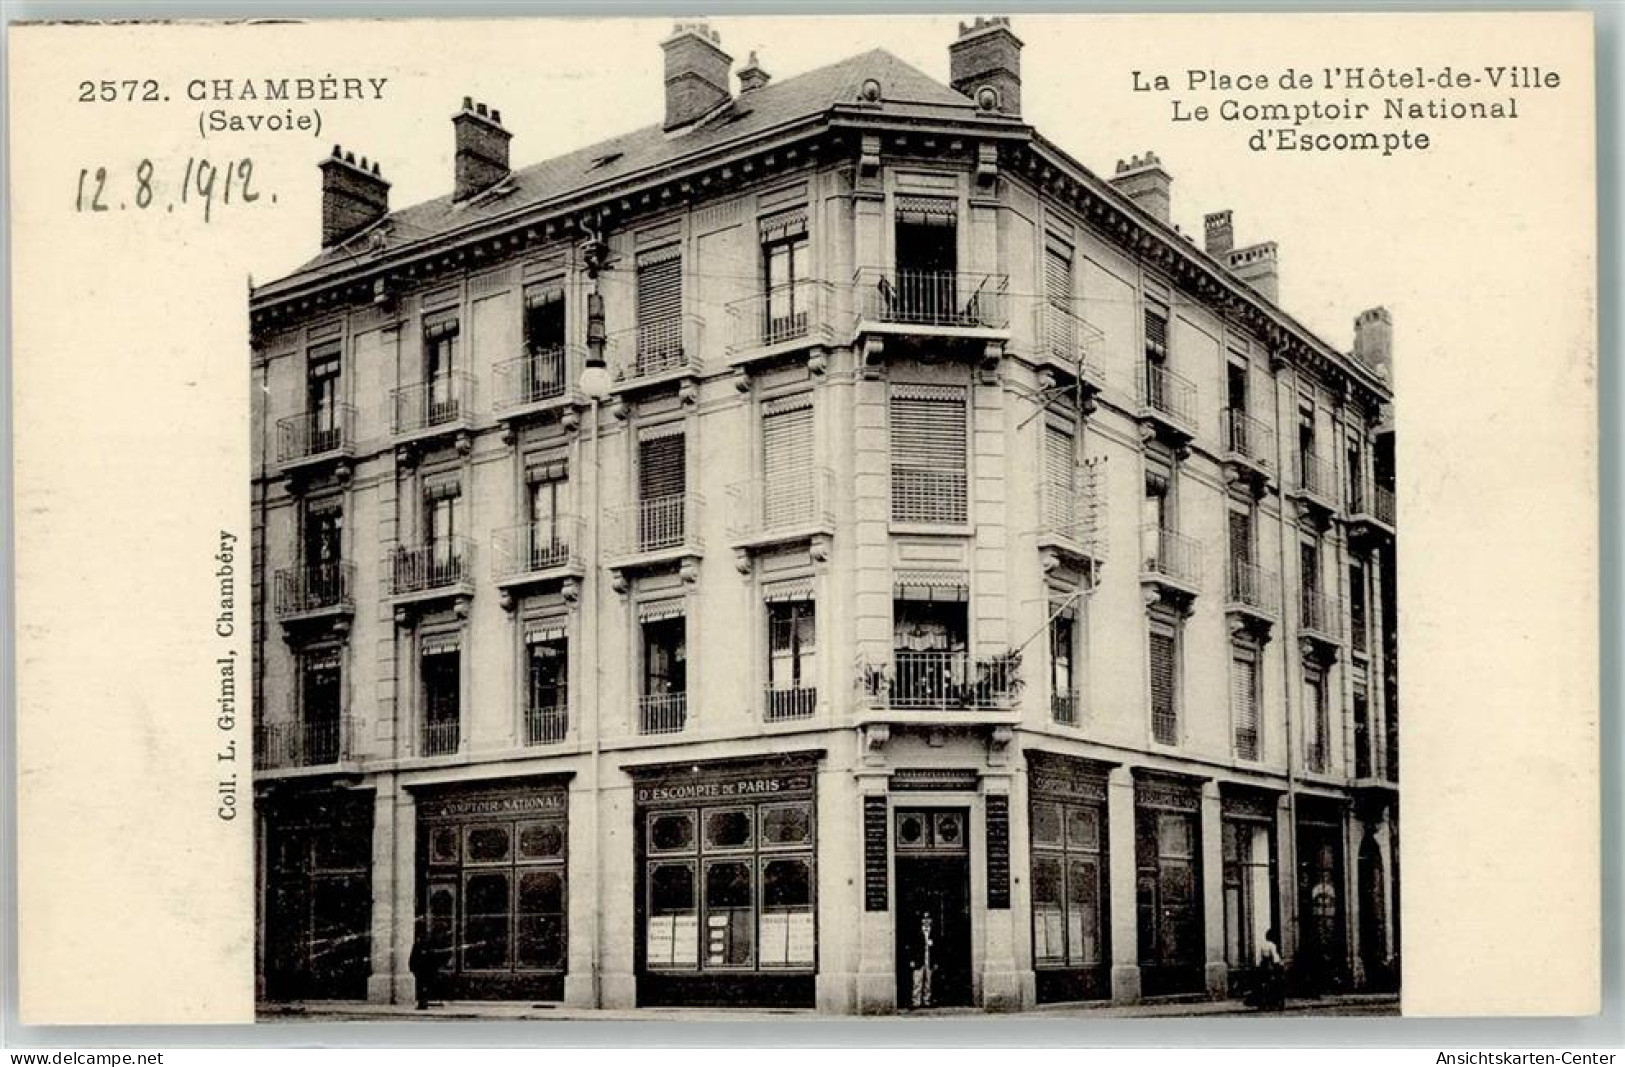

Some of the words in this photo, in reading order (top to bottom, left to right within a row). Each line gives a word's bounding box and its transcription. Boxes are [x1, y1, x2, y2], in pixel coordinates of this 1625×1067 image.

[78, 79, 171, 103] 2572.
[187, 73, 388, 101] CHAMBÉRY
[1132, 70, 1170, 91] La
[1187, 69, 1269, 91] Place
[1278, 68, 1313, 90] de
[1324, 66, 1560, 90] l'Hôtel-de-Ville
[199, 108, 322, 138] (Savoie)
[1172, 100, 1209, 122] Le
[1219, 98, 1370, 126] Comptoir
[1383, 97, 1519, 120] National
[1248, 128, 1430, 157] d'Escompte
[214, 530, 238, 638] Chambéry
[217, 649, 238, 731] Grimal,
[217, 740, 236, 761] L.
[217, 773, 237, 821] Coll.
[738, 779, 780, 793] PARIS
[502, 796, 561, 812] NATIONAL
